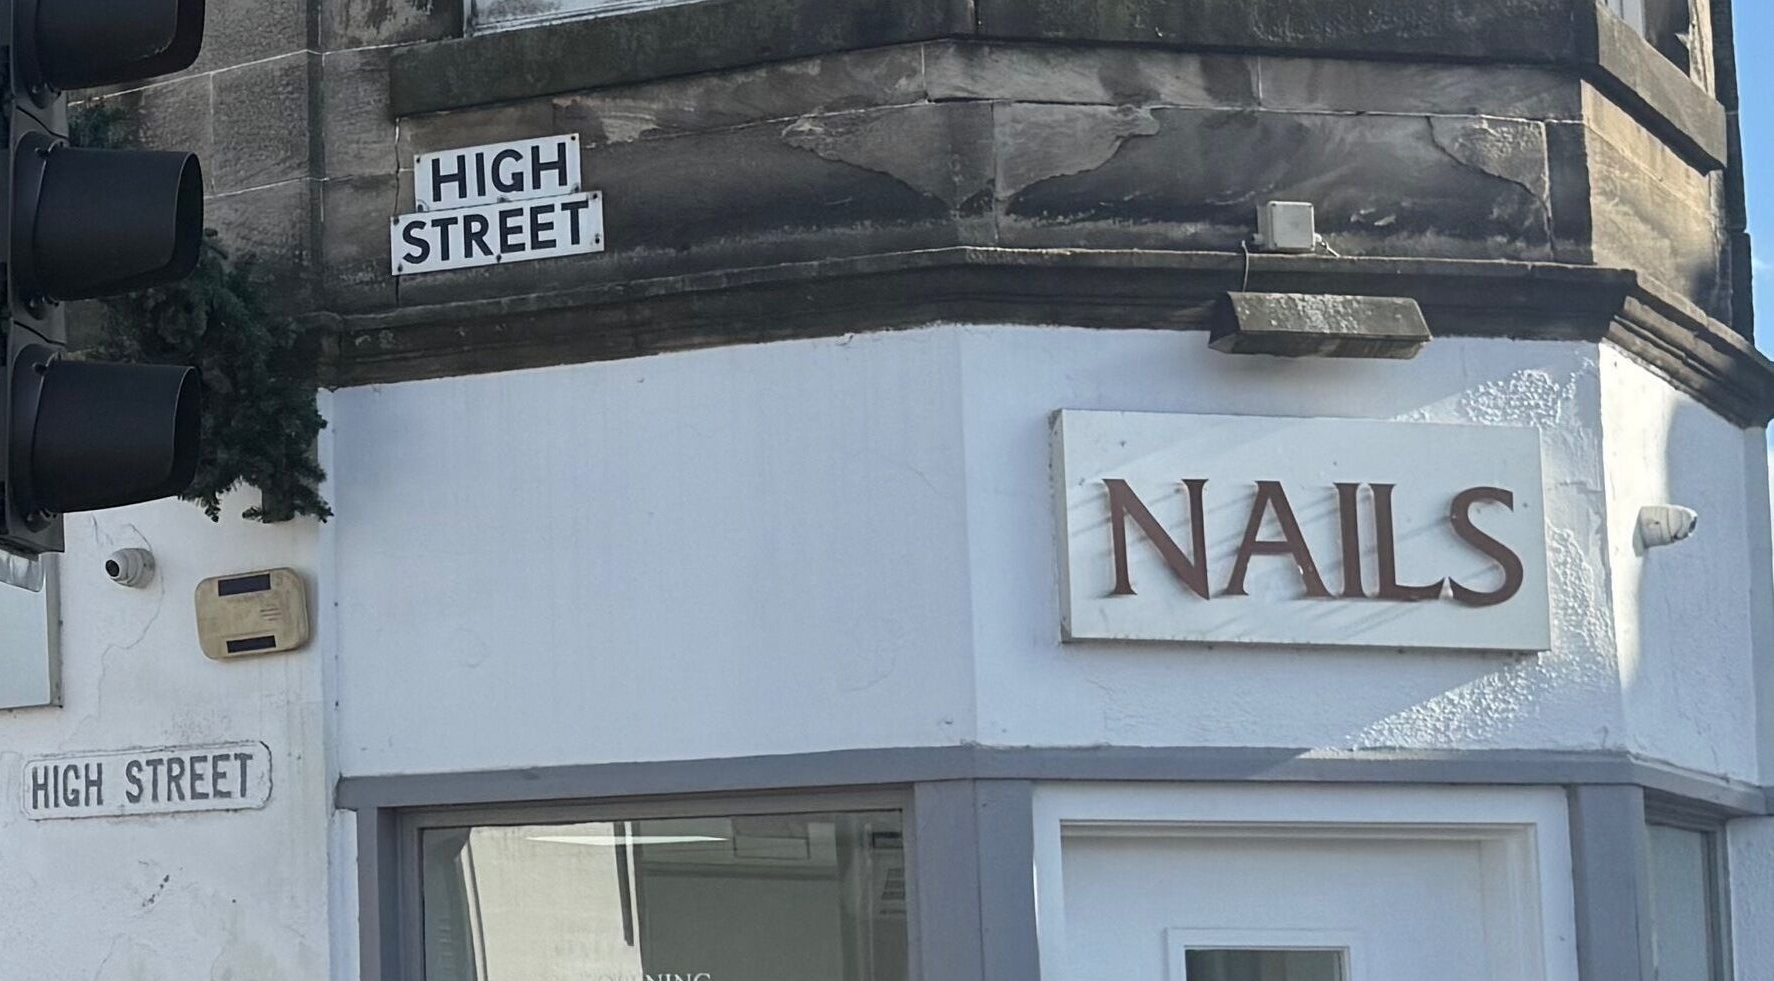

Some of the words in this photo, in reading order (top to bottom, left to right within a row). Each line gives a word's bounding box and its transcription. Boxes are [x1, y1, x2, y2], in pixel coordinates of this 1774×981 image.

[431, 142, 568, 203] HIGH
[402, 200, 589, 264] STREET
[1101, 478, 1524, 607] NAILS
[32, 762, 103, 809] HIGH
[126, 753, 253, 804] STREET
